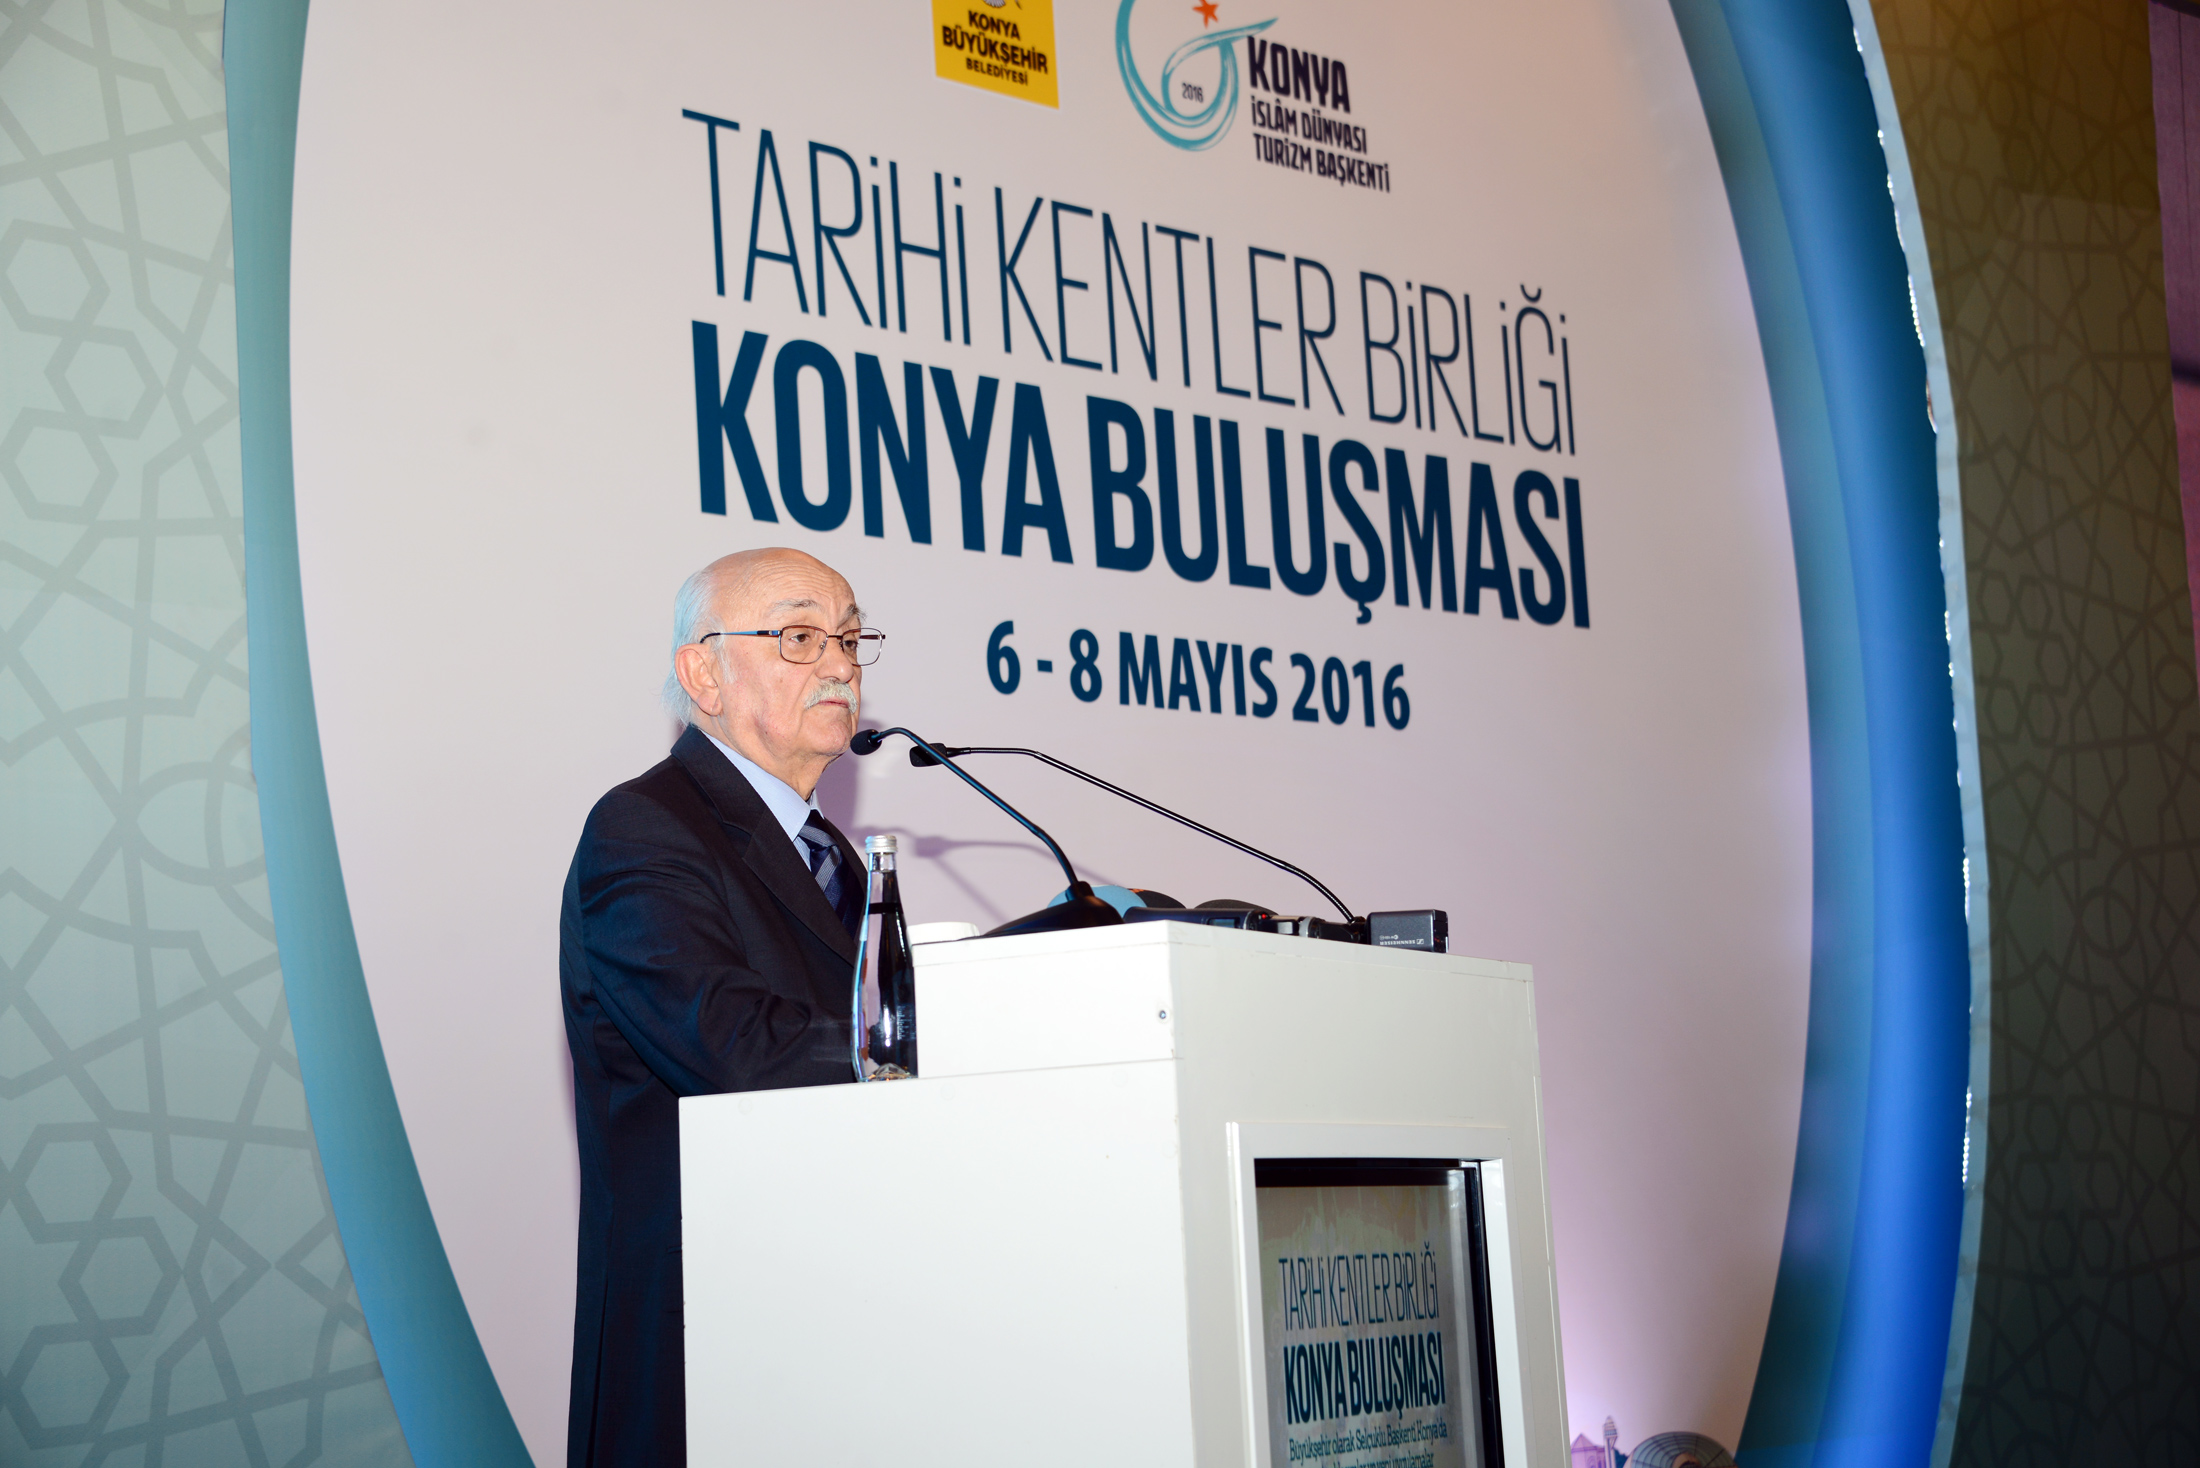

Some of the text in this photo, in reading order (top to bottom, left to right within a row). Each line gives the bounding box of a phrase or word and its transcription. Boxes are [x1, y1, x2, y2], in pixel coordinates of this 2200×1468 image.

[942, 24, 1048, 74] BÜYÜKŞEHİR
[968, 10, 1021, 41] KONYA
[966, 57, 1028, 86] BELEDİYESİ
[1182, 82, 1204, 103] 2016
[1247, 35, 1351, 114] KONYA
[1251, 96, 1368, 155] İSLÂM DÜNYASI
[1254, 133, 1391, 193] TURİZM BAŞKENTİ
[682, 109, 1577, 457] TARİHİ KENTLER BİRLİĞİ
[692, 321, 1591, 630] KONYA BULUŞMASI
[986, 621, 1020, 695] 6
[1069, 629, 1103, 703] 8
[1119, 632, 1278, 718] MAYIS
[1290, 653, 1411, 731] 2016
[1279, 1241, 1440, 1330] TARİHİ KENTLER BİRLİĞİ
[1283, 1332, 1446, 1425] KONYA BULUŞMASI
[1331, 1431, 1355, 1454] olarak
